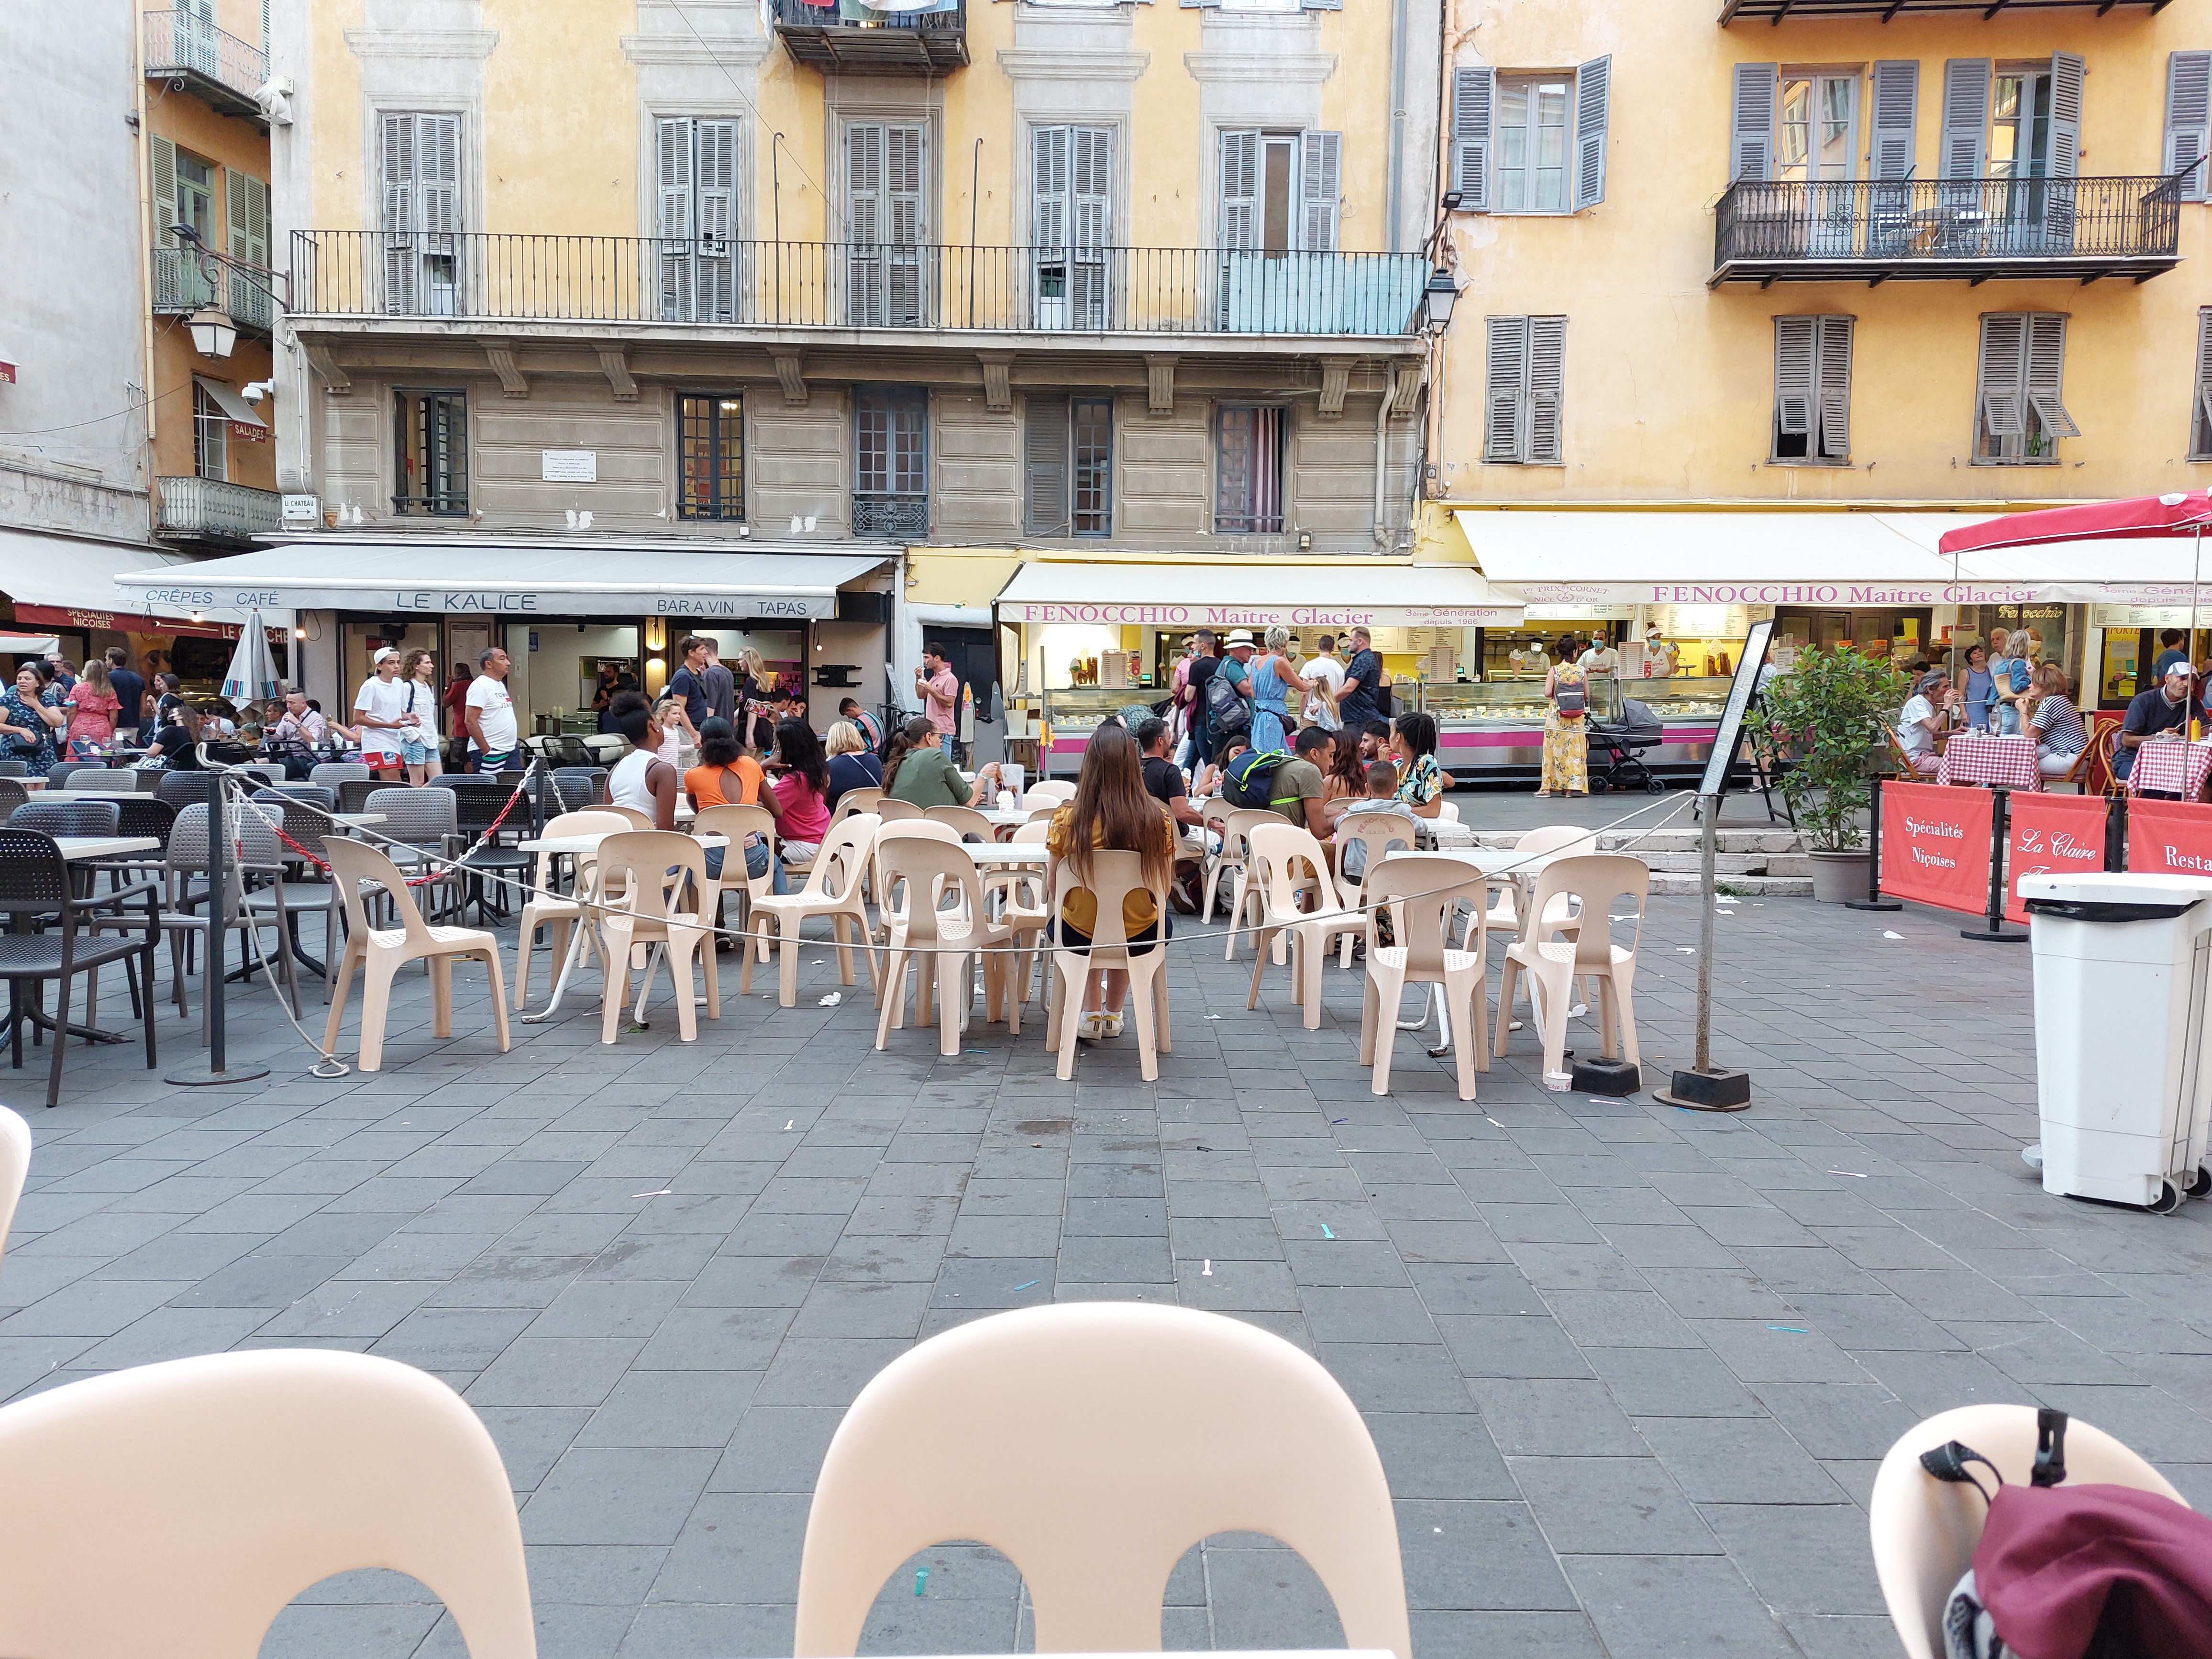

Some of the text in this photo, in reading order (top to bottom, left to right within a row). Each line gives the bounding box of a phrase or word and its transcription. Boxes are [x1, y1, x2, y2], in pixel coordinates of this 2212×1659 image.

[235, 424, 264, 439] SALADES
[146, 589, 279, 605] CRÊPES CAFÉ
[1570, 586, 1610, 594] CORNET
[1652, 585, 2038, 602] FENOCCHIO Maître Glacier
[397, 593, 537, 610] LE KALICE
[658, 599, 807, 615] BAR A VIN TAPAS
[1024, 605, 1373, 624] FENOCCHIO Maître Glacier
[1433, 608, 1497, 617] Génération
[73, 618, 111, 629] NICOISES
[222, 625, 235, 639] LE
[1905, 816, 1963, 839] Spécialités
[2017, 829, 2096, 860] La Claire
[1911, 846, 1956, 869] Niçoises
[2163, 845, 2212, 872] Resta
